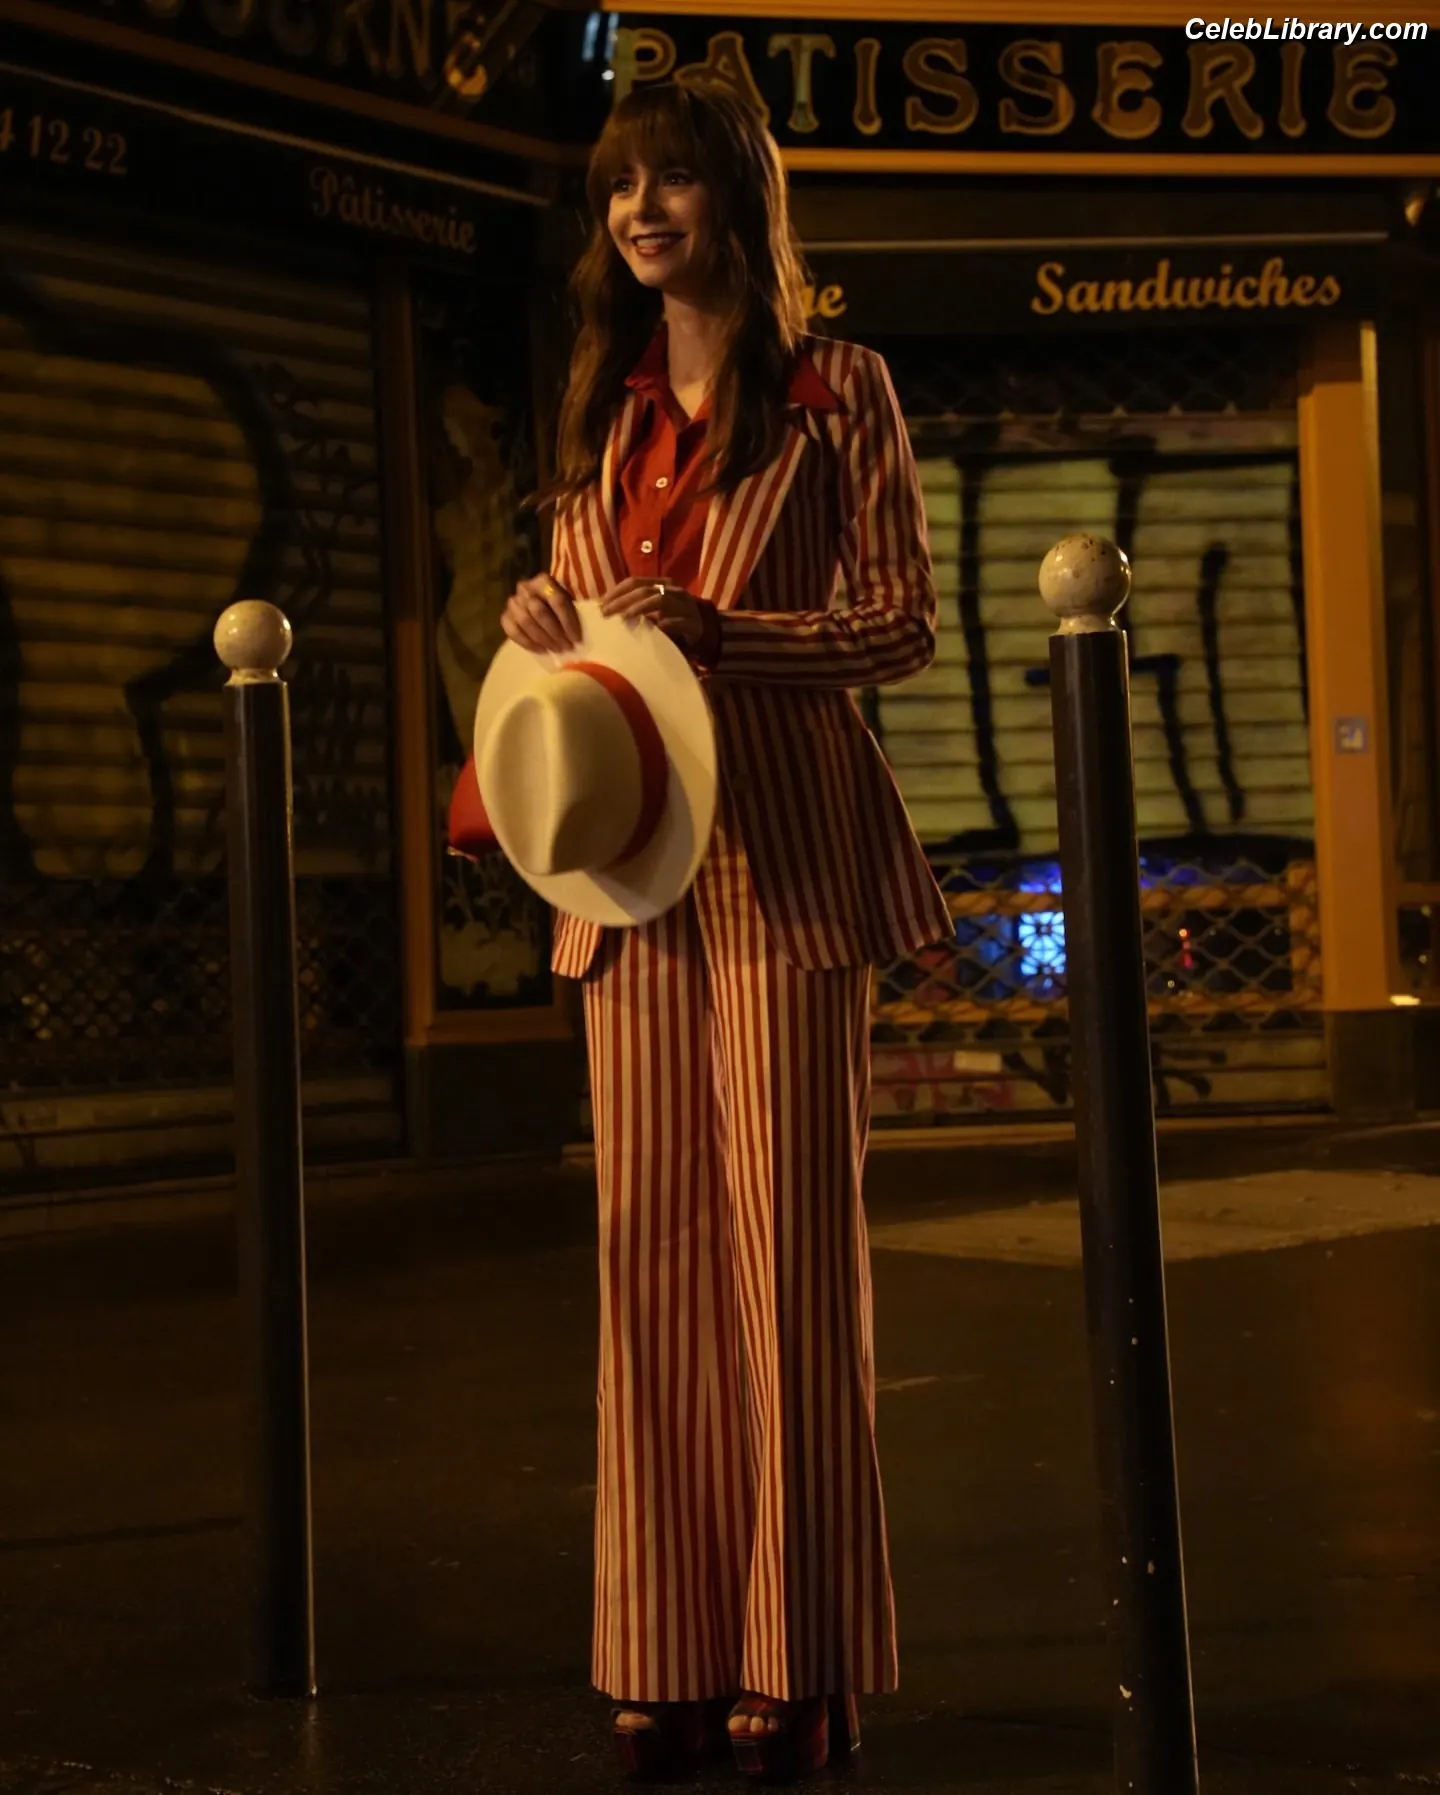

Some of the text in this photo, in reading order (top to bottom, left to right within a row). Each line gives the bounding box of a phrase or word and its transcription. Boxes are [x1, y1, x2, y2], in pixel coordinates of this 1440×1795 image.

[611, 26, 1400, 140] PATISSERIE
[26, 112, 71, 164] 12
[81, 124, 129, 176] 22
[308, 165, 478, 255] Pâtisserie
[1030, 256, 1342, 316] Sandwiches
